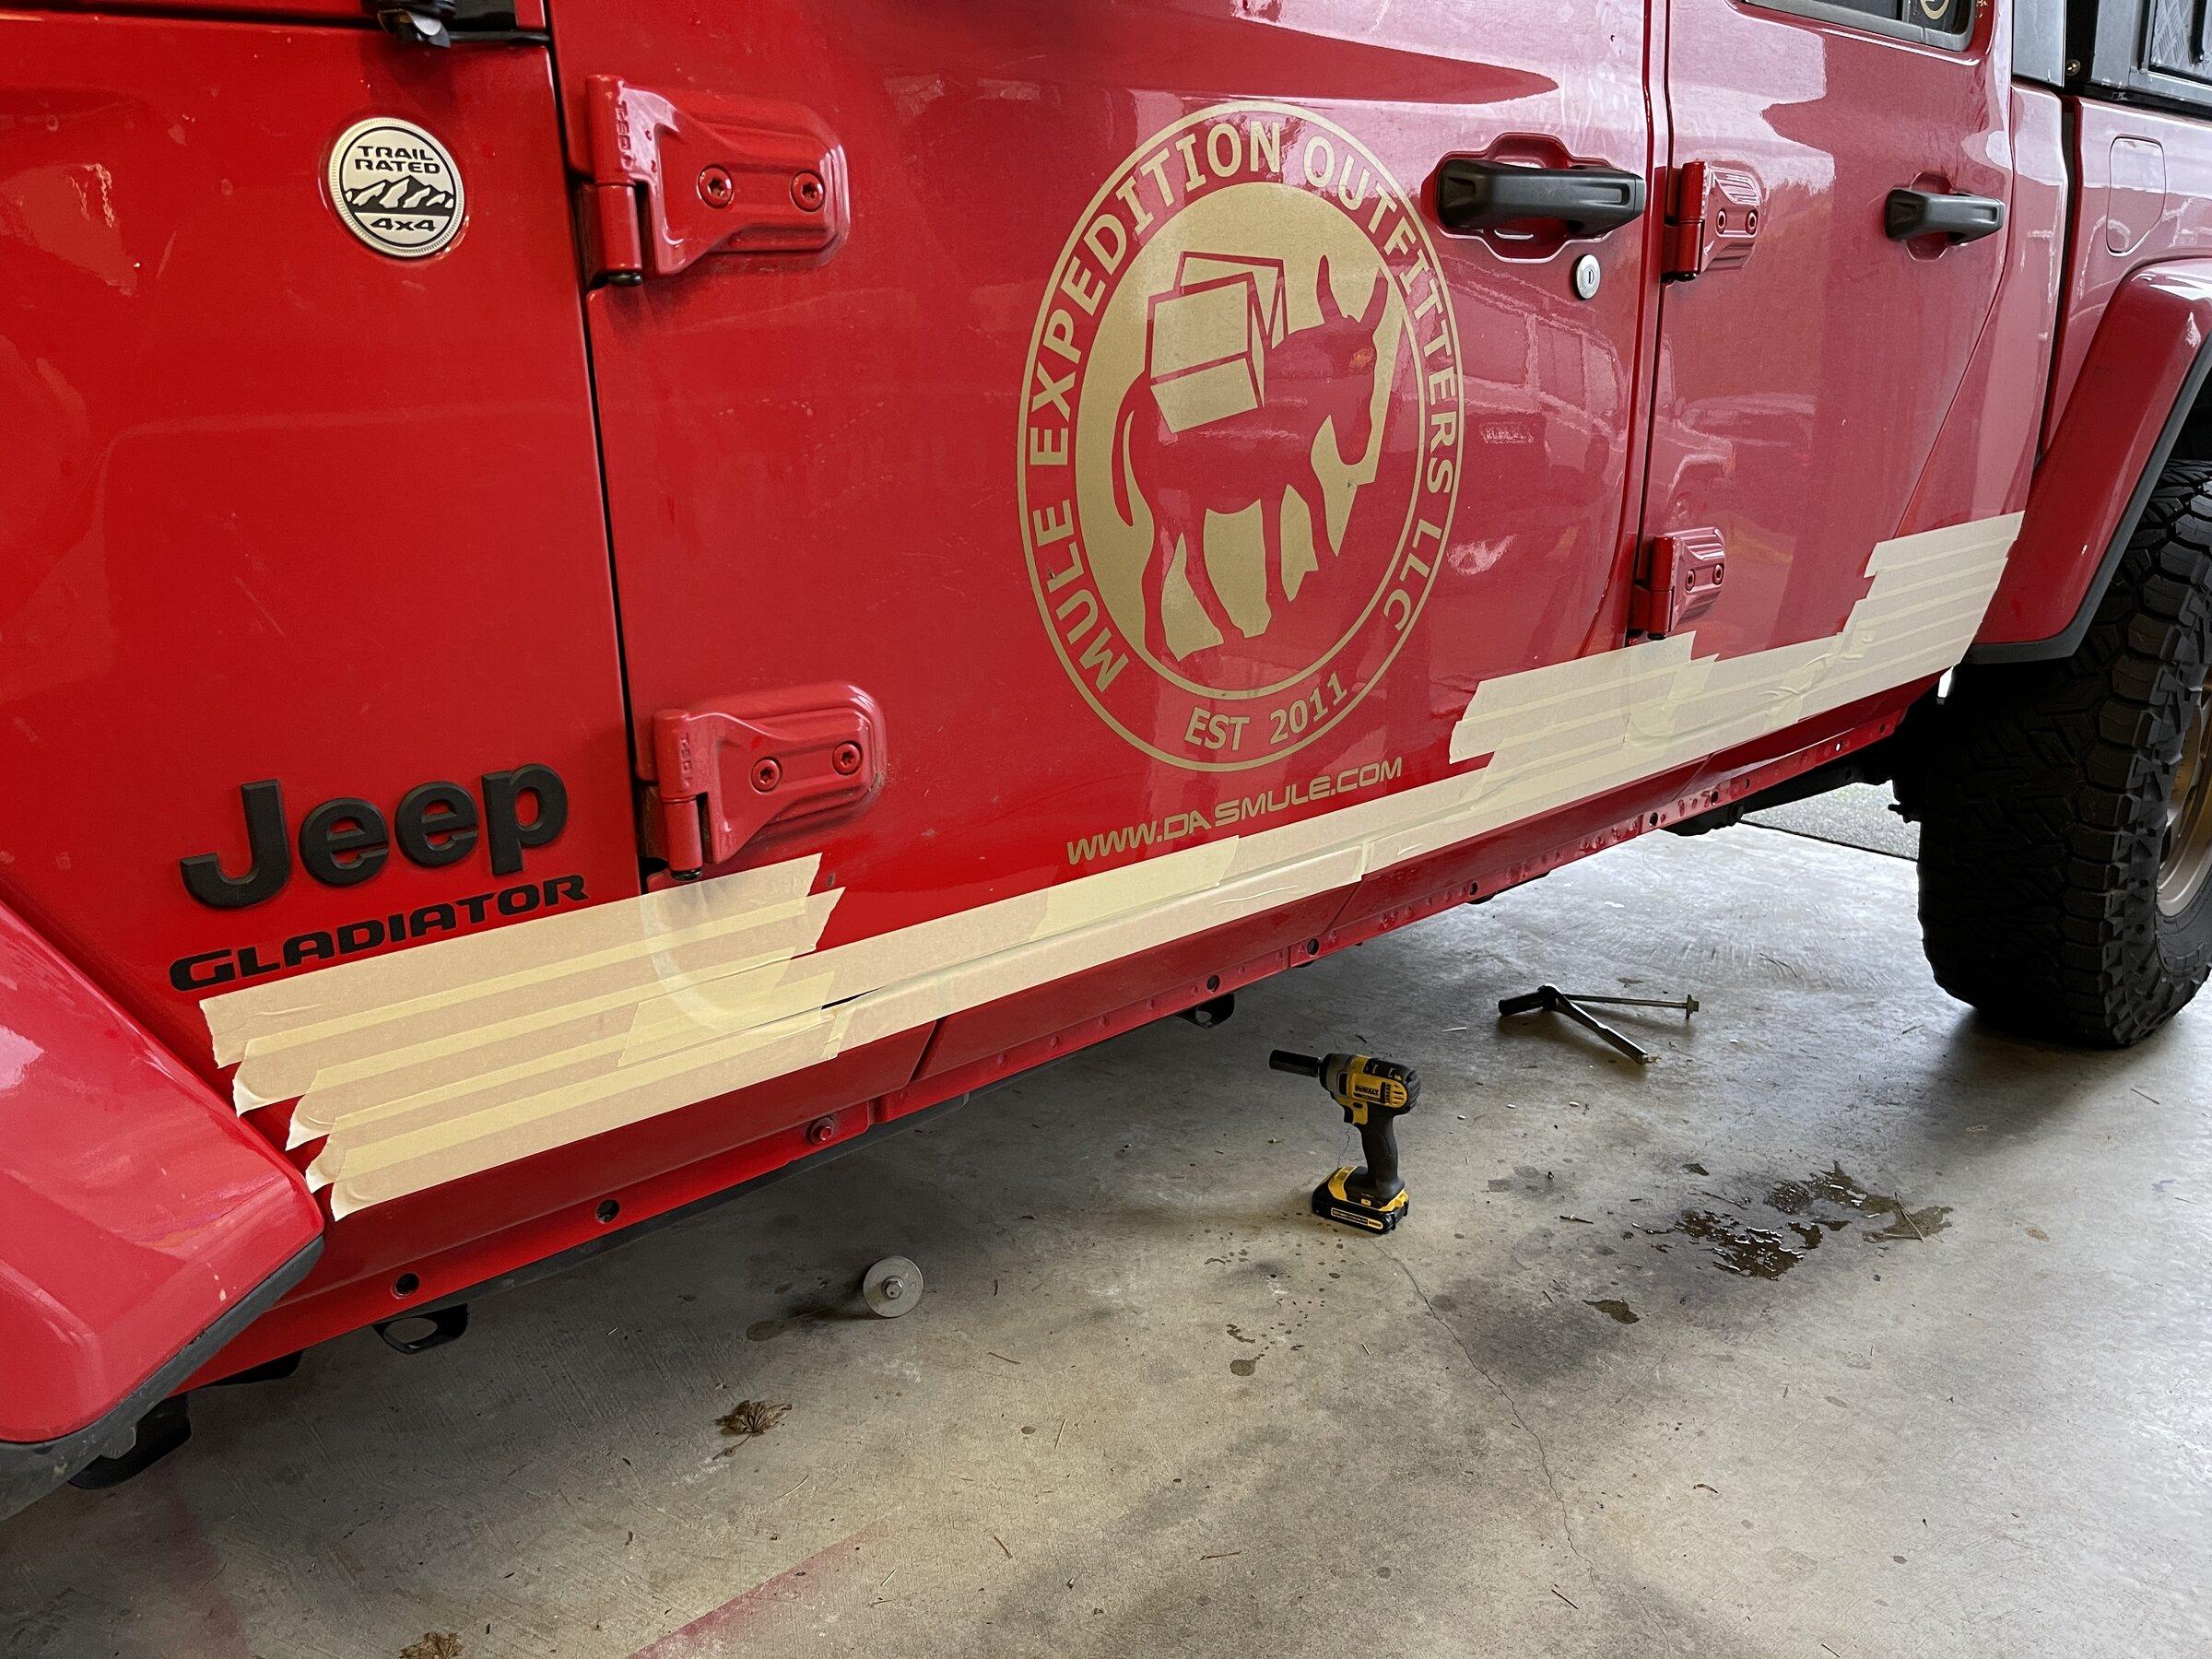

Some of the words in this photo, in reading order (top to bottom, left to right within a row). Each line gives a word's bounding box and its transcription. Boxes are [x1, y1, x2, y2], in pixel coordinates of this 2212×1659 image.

[355, 159, 441, 174] RATED
[357, 145, 434, 161] TRAIL
[1030, 120, 1281, 465] EXPEDITION
[1303, 135, 1457, 495] OUTFITTERS
[1033, 499, 1129, 693] MULE
[1383, 517, 1442, 630] LLC
[1184, 706, 1250, 751] EST
[1268, 671, 1348, 745] 2011
[179, 762, 570, 911] Jeep
[169, 873, 591, 992] GLADIATOR
